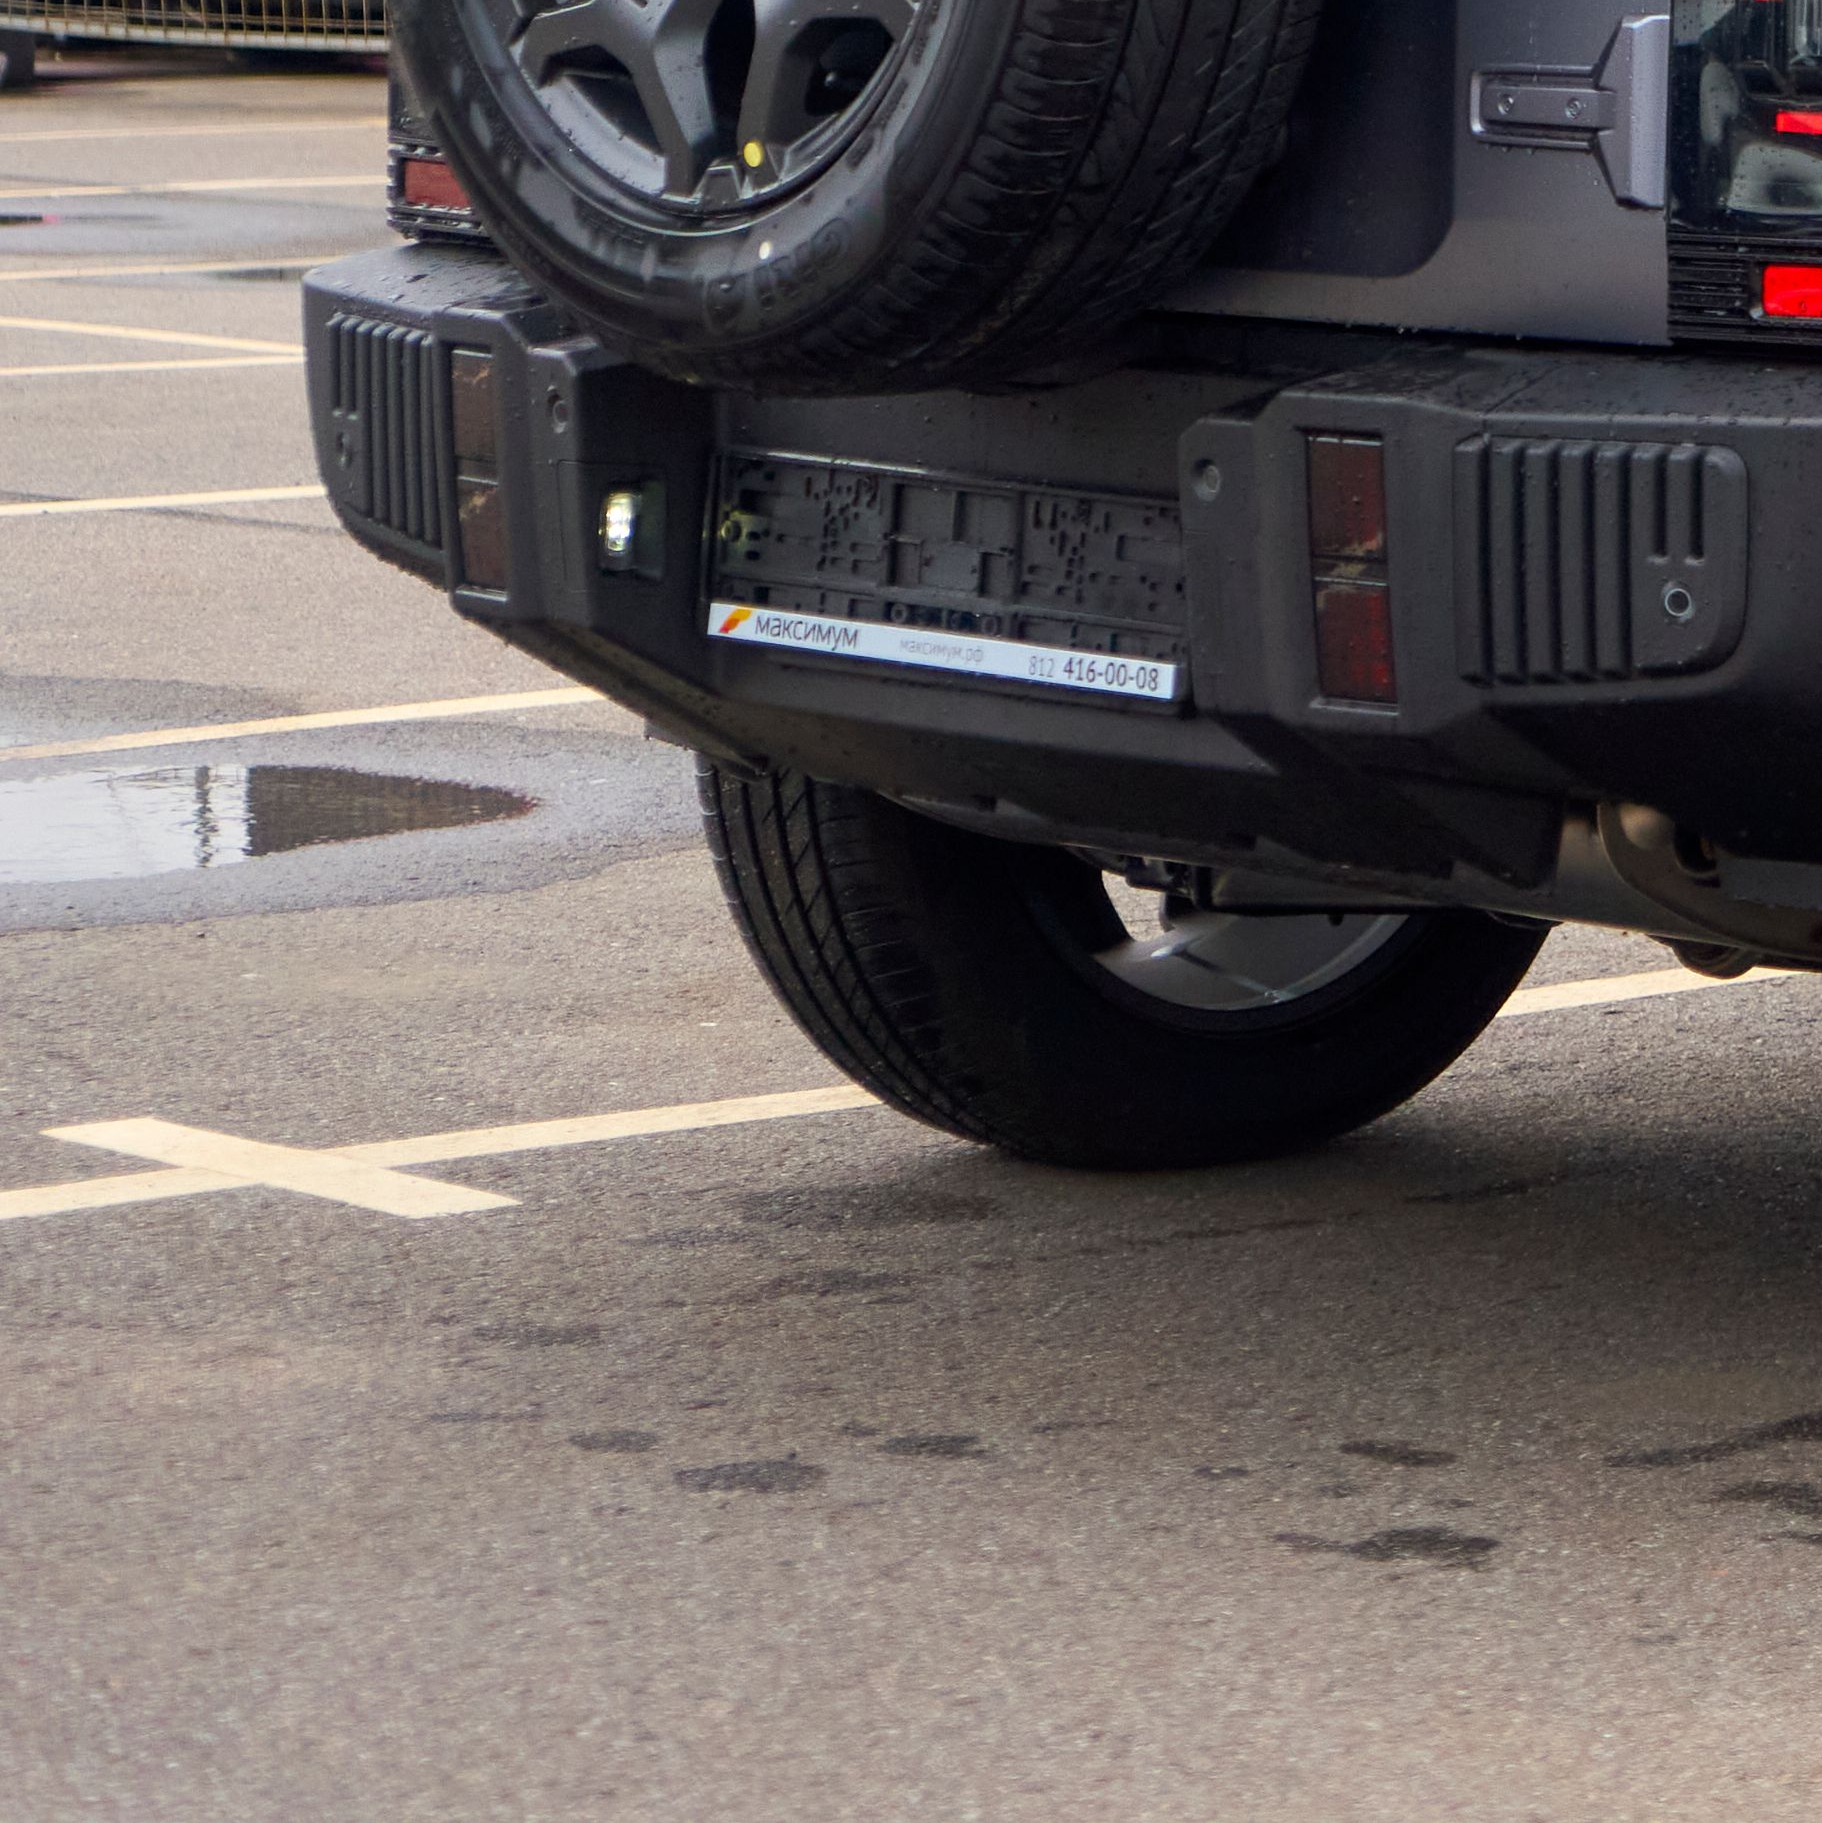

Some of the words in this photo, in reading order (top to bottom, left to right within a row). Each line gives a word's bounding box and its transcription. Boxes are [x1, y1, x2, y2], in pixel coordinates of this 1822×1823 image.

[754, 615, 859, 651] максимум
[1028, 655, 1055, 678] 812
[1063, 657, 1159, 691] 416-00-08
